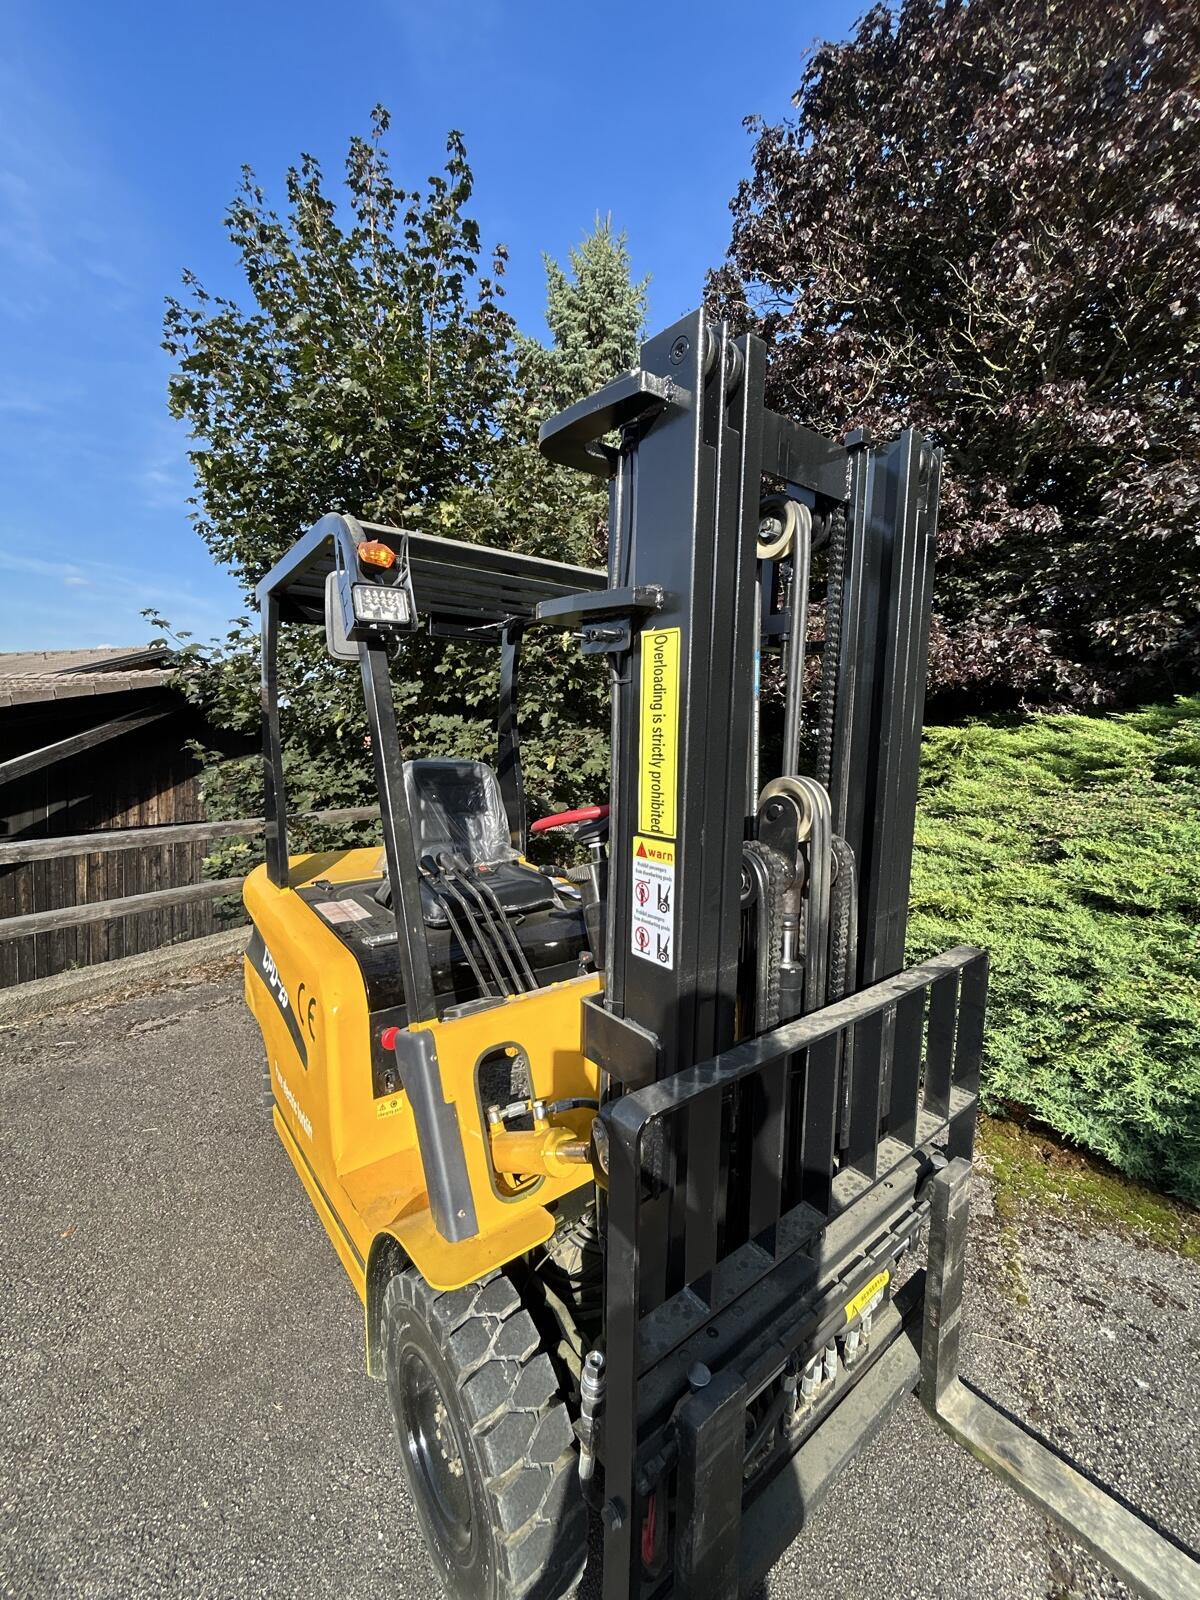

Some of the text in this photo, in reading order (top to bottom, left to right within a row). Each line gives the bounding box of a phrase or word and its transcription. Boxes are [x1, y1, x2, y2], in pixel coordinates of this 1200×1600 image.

[648, 633, 668, 834] Overloading is strictly prohibited
[647, 848, 673, 862] warn
[297, 982, 317, 1043] CE
